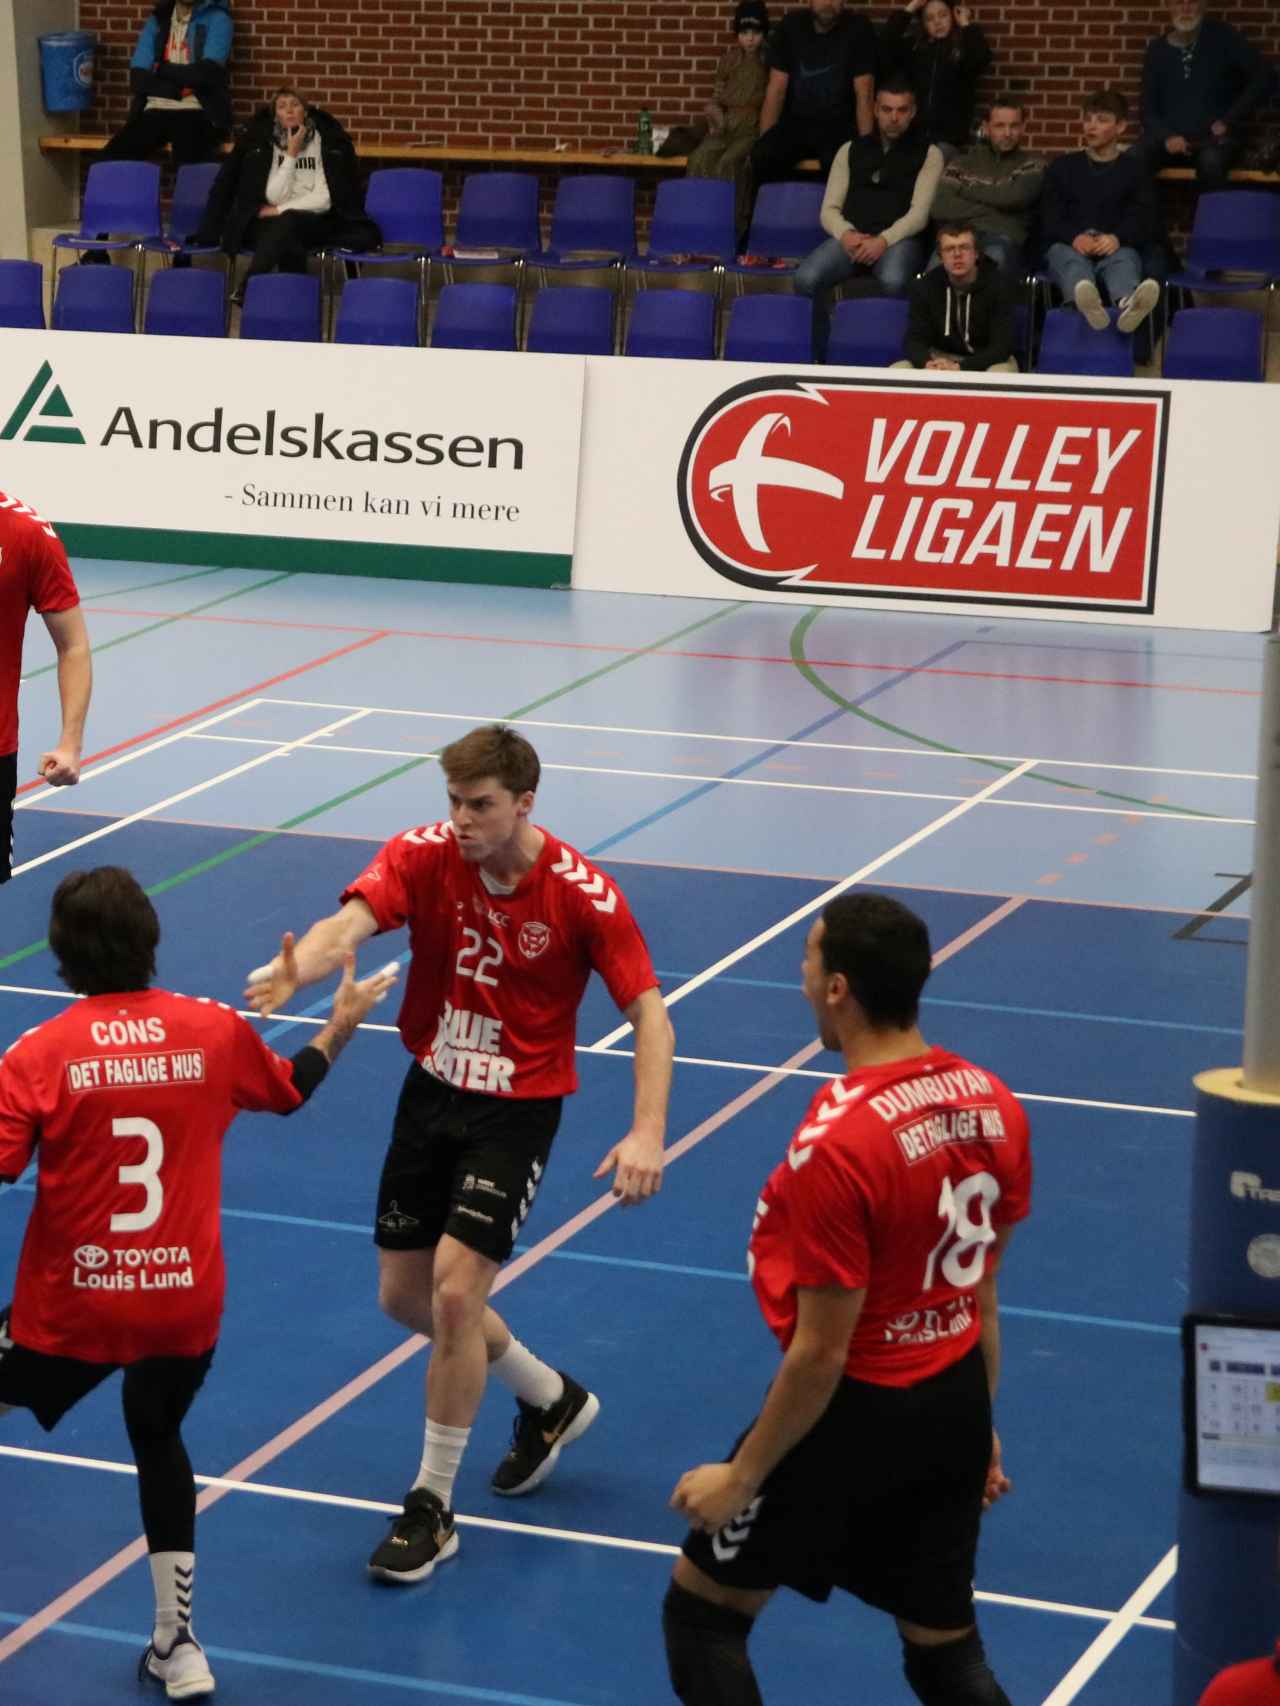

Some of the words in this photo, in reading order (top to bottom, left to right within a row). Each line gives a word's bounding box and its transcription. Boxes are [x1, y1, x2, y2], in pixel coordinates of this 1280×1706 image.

[100, 406, 524, 470] Andelskassen
[864, 418, 1142, 494] VOLLEY
[241, 483, 352, 513] Sammen
[363, 491, 411, 516] kan
[418, 495, 439, 517] vi
[449, 500, 520, 522] mere
[851, 495, 1133, 573] LIGAEN
[455, 926, 504, 987] 22
[90, 1016, 167, 1046] CONS
[70, 1060, 101, 1090] DET
[104, 1055, 169, 1085] FAGLIGE
[171, 1053, 203, 1081] HUS
[899, 1123, 932, 1160] DET
[109, 1116, 165, 1232] 3
[922, 1171, 1001, 1291] 18
[73, 1266, 136, 1290] Louis
[140, 1266, 195, 1289] Lund
[113, 1246, 191, 1267] TOYOTA
